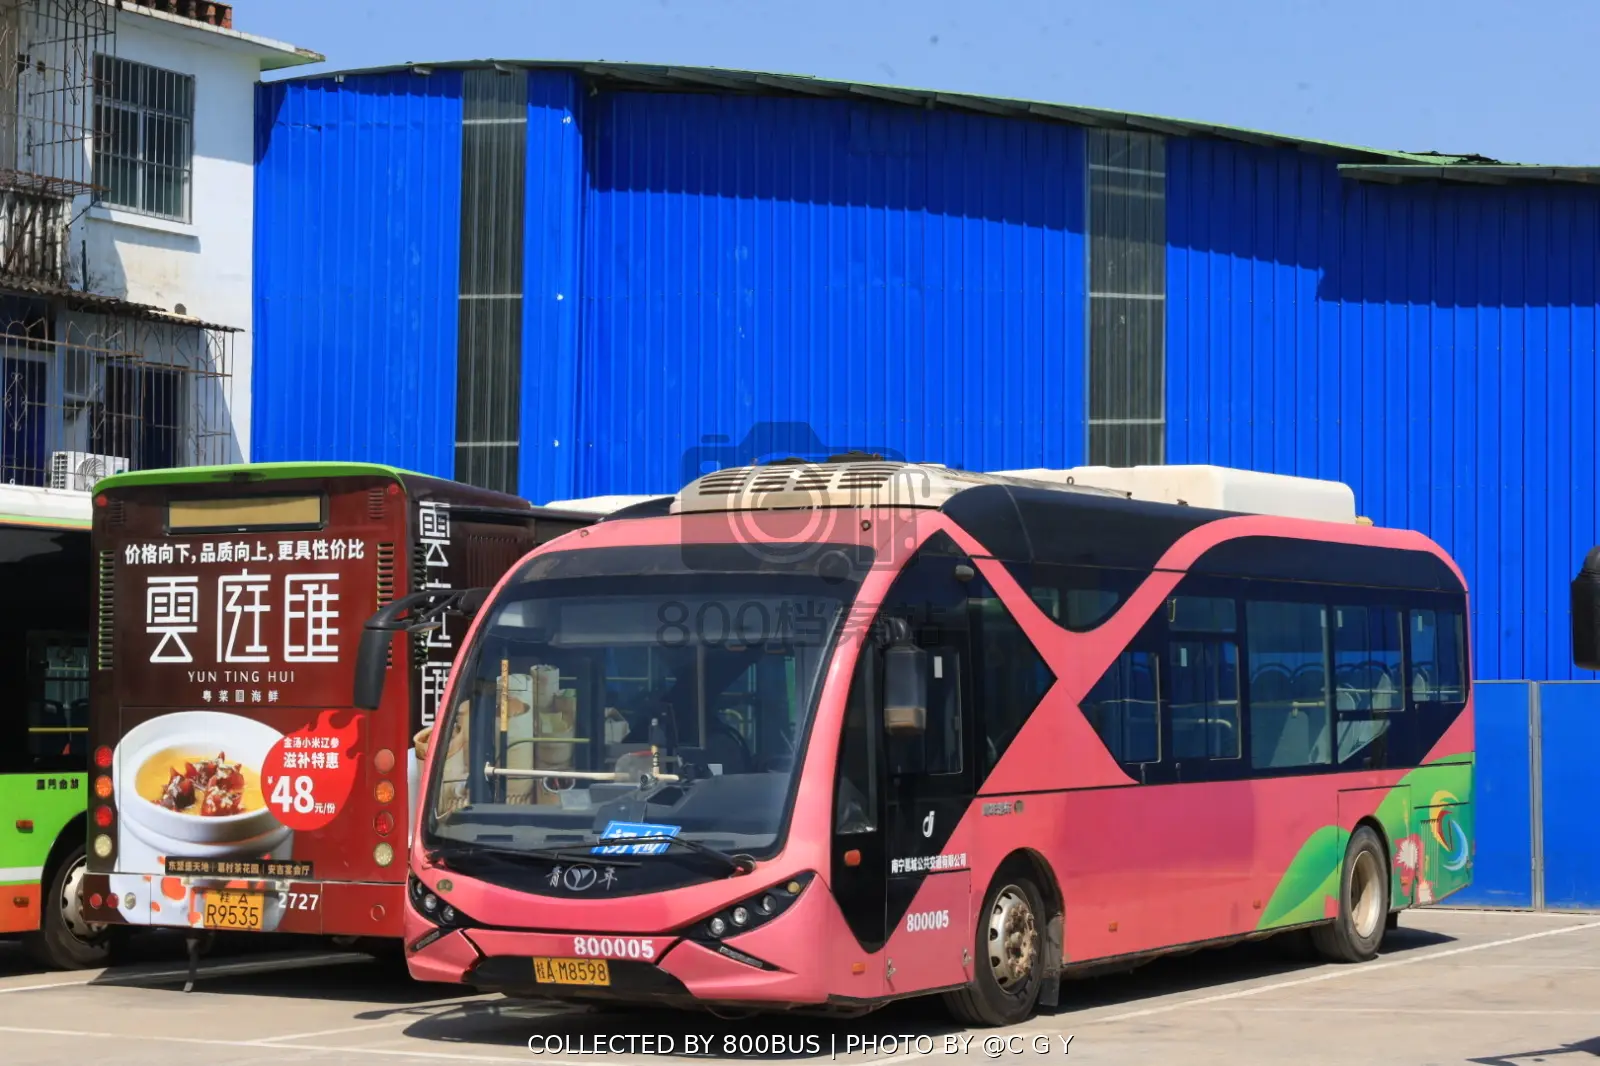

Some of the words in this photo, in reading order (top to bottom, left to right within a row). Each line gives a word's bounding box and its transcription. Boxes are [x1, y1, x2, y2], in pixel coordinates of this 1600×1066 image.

[188, 671, 217, 682] YUN
[224, 671, 260, 682] TING
[268, 671, 295, 682] HUI
[283, 751, 340, 769] 滋补特惠
[278, 892, 320, 911] 2727
[206, 904, 259, 927] R9535
[906, 909, 950, 933] 800005
[573, 936, 655, 959] 800005
